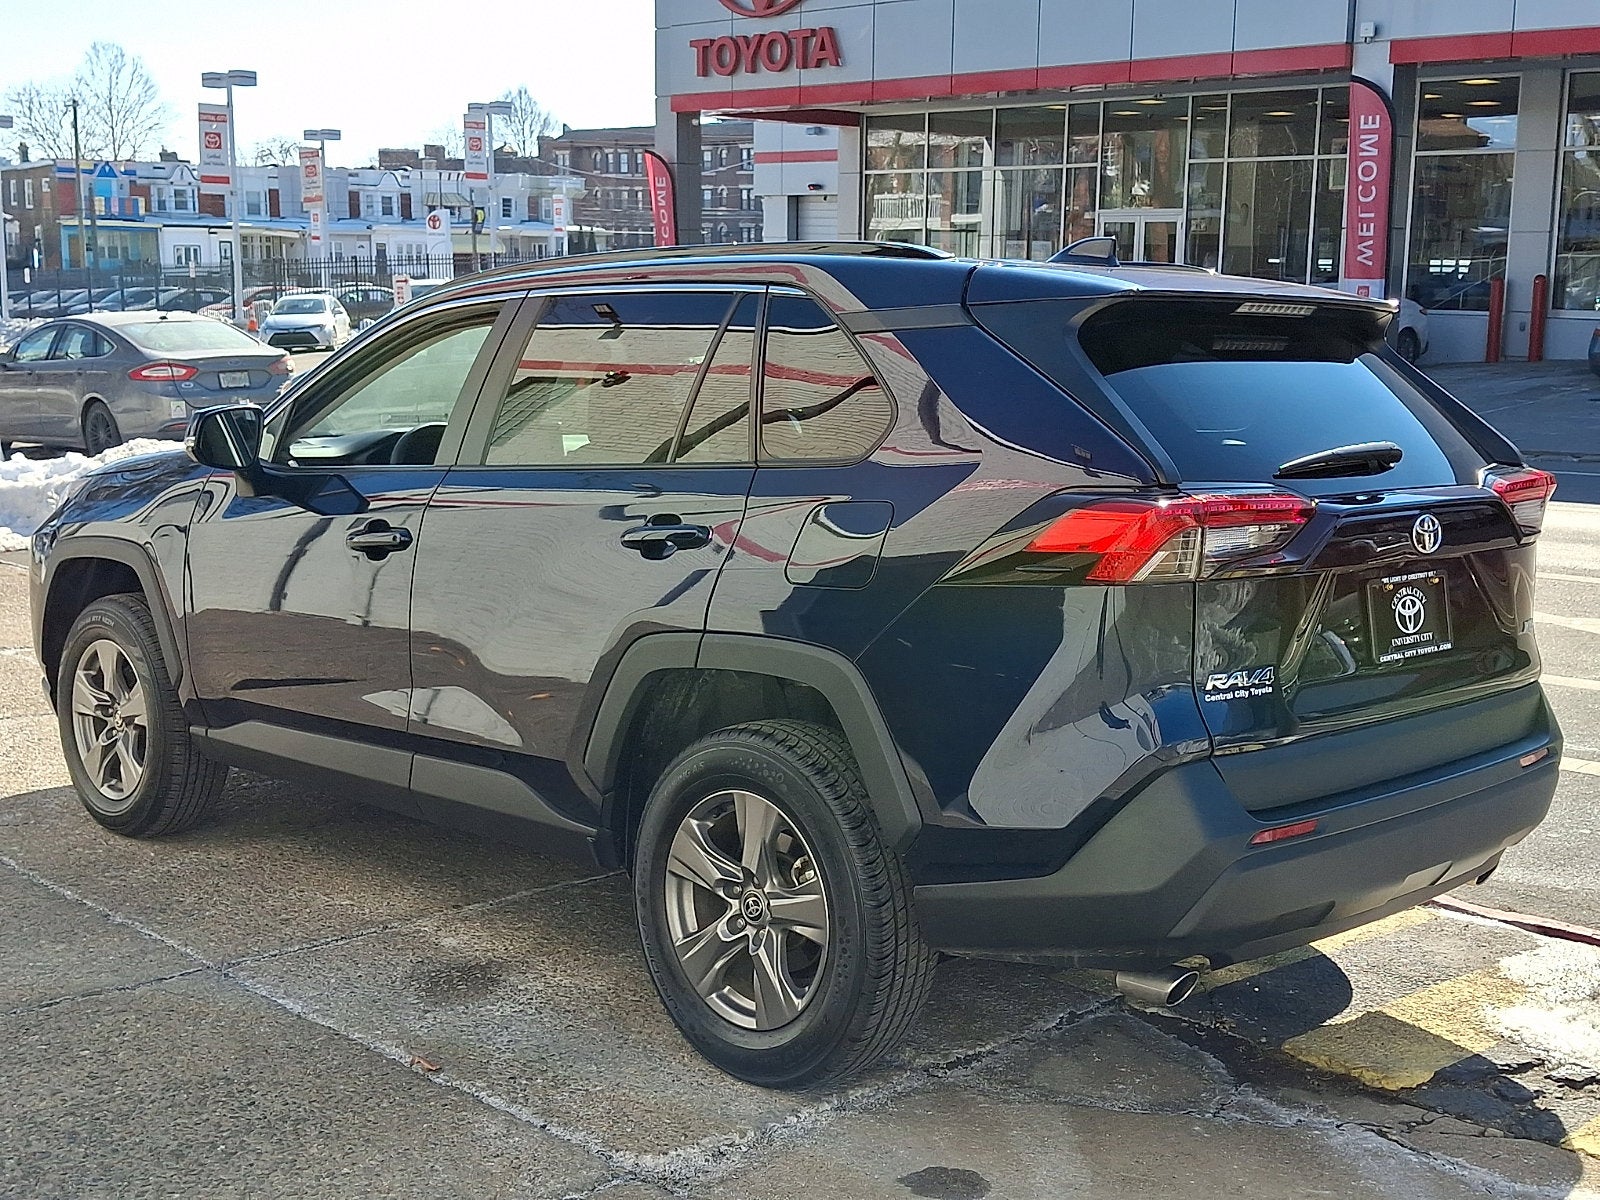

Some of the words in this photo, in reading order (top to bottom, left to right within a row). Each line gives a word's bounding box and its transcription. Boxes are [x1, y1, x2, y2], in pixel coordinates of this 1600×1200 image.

[690, 26, 841, 77] TOYOTA
[1391, 586, 1413, 610] CENTRAL
[1413, 587, 1427, 604] CITY
[1391, 634, 1420, 647] UNIVERSITY
[1420, 631, 1434, 641] CITY
[1380, 653, 1404, 662] CENTRAL
[1404, 649, 1417, 657] CITY
[1205, 666, 1274, 691] RAV4
[1204, 691, 1233, 702] Central
[1234, 689, 1250, 699] City
[1250, 686, 1273, 697] Toyota
